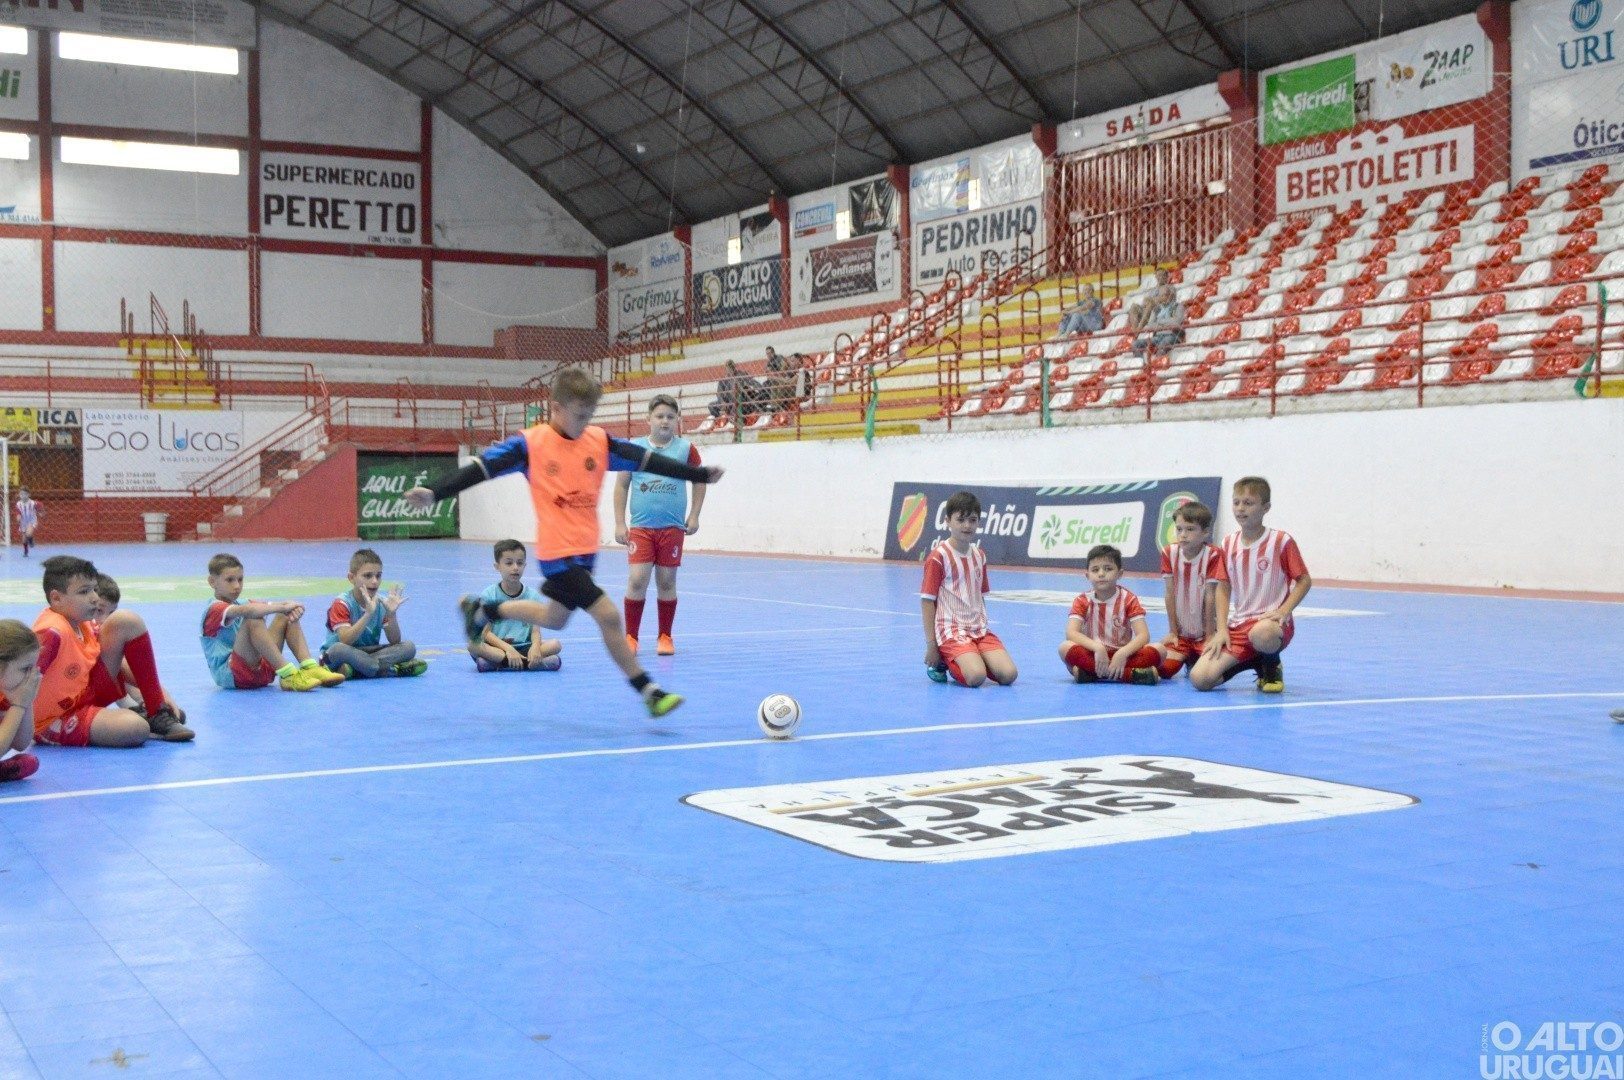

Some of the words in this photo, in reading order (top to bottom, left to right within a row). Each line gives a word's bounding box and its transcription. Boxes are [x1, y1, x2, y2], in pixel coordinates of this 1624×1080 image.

[1558, 30, 1615, 70] URI
[1293, 82, 1347, 111] Sicredi
[263, 164, 415, 190] SUPERMERCADO
[1287, 139, 1458, 202] BERTOLETTI
[264, 194, 416, 234] PERETTO
[921, 204, 1037, 256] PEDRINHO
[739, 260, 772, 287] ALTO
[815, 262, 872, 287] Confiança
[623, 289, 680, 318] Grafimax
[722, 283, 772, 308] URUGUAI
[85, 412, 150, 421] Laboratório
[86, 422, 149, 451] São
[1063, 517, 1133, 545] Sicredi
[856, 794, 1178, 849] SUPER
